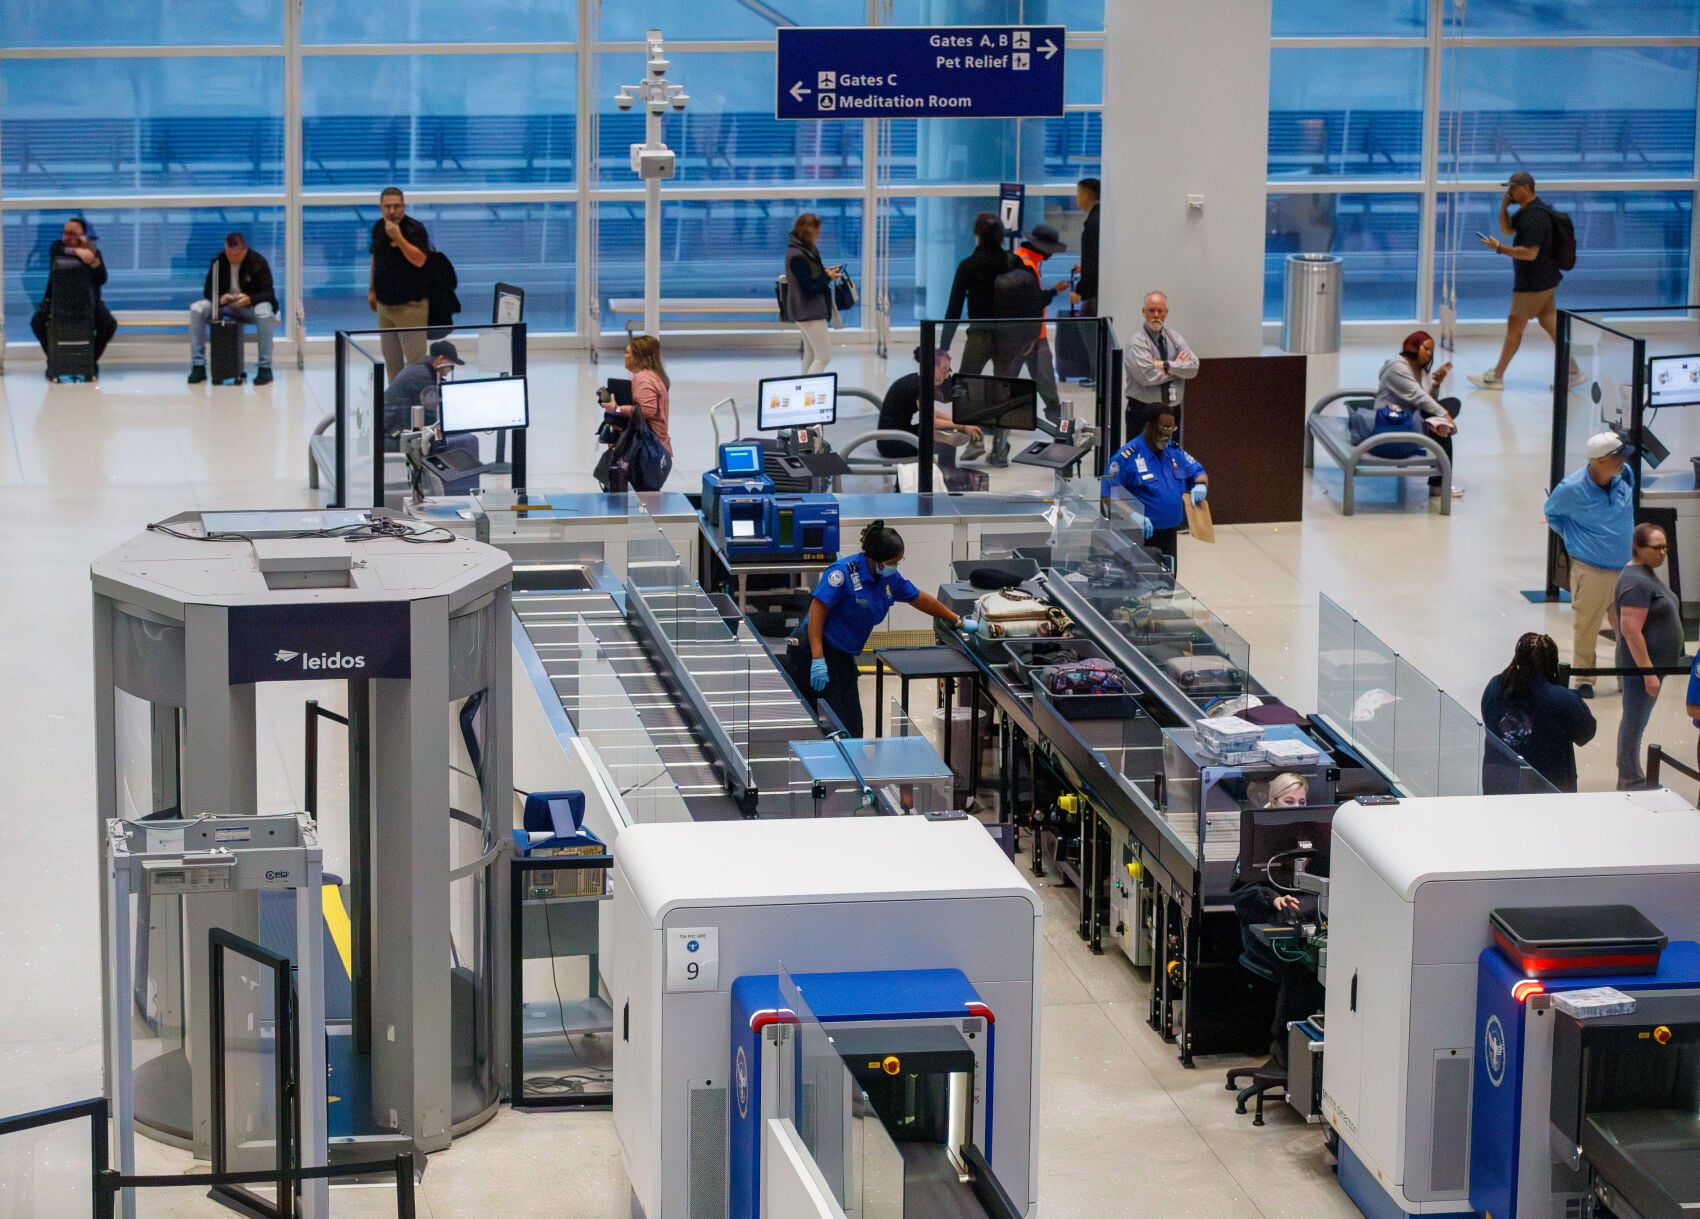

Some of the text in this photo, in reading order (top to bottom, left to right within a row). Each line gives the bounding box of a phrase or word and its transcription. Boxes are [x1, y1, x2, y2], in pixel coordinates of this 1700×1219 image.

[929, 34, 1008, 48] Gates A, B
[936, 55, 1008, 68] Pet Relief
[839, 73, 897, 86] Gates C
[839, 95, 972, 108] Meditation Room
[302, 651, 366, 670] leidos
[687, 962, 699, 980] 9
